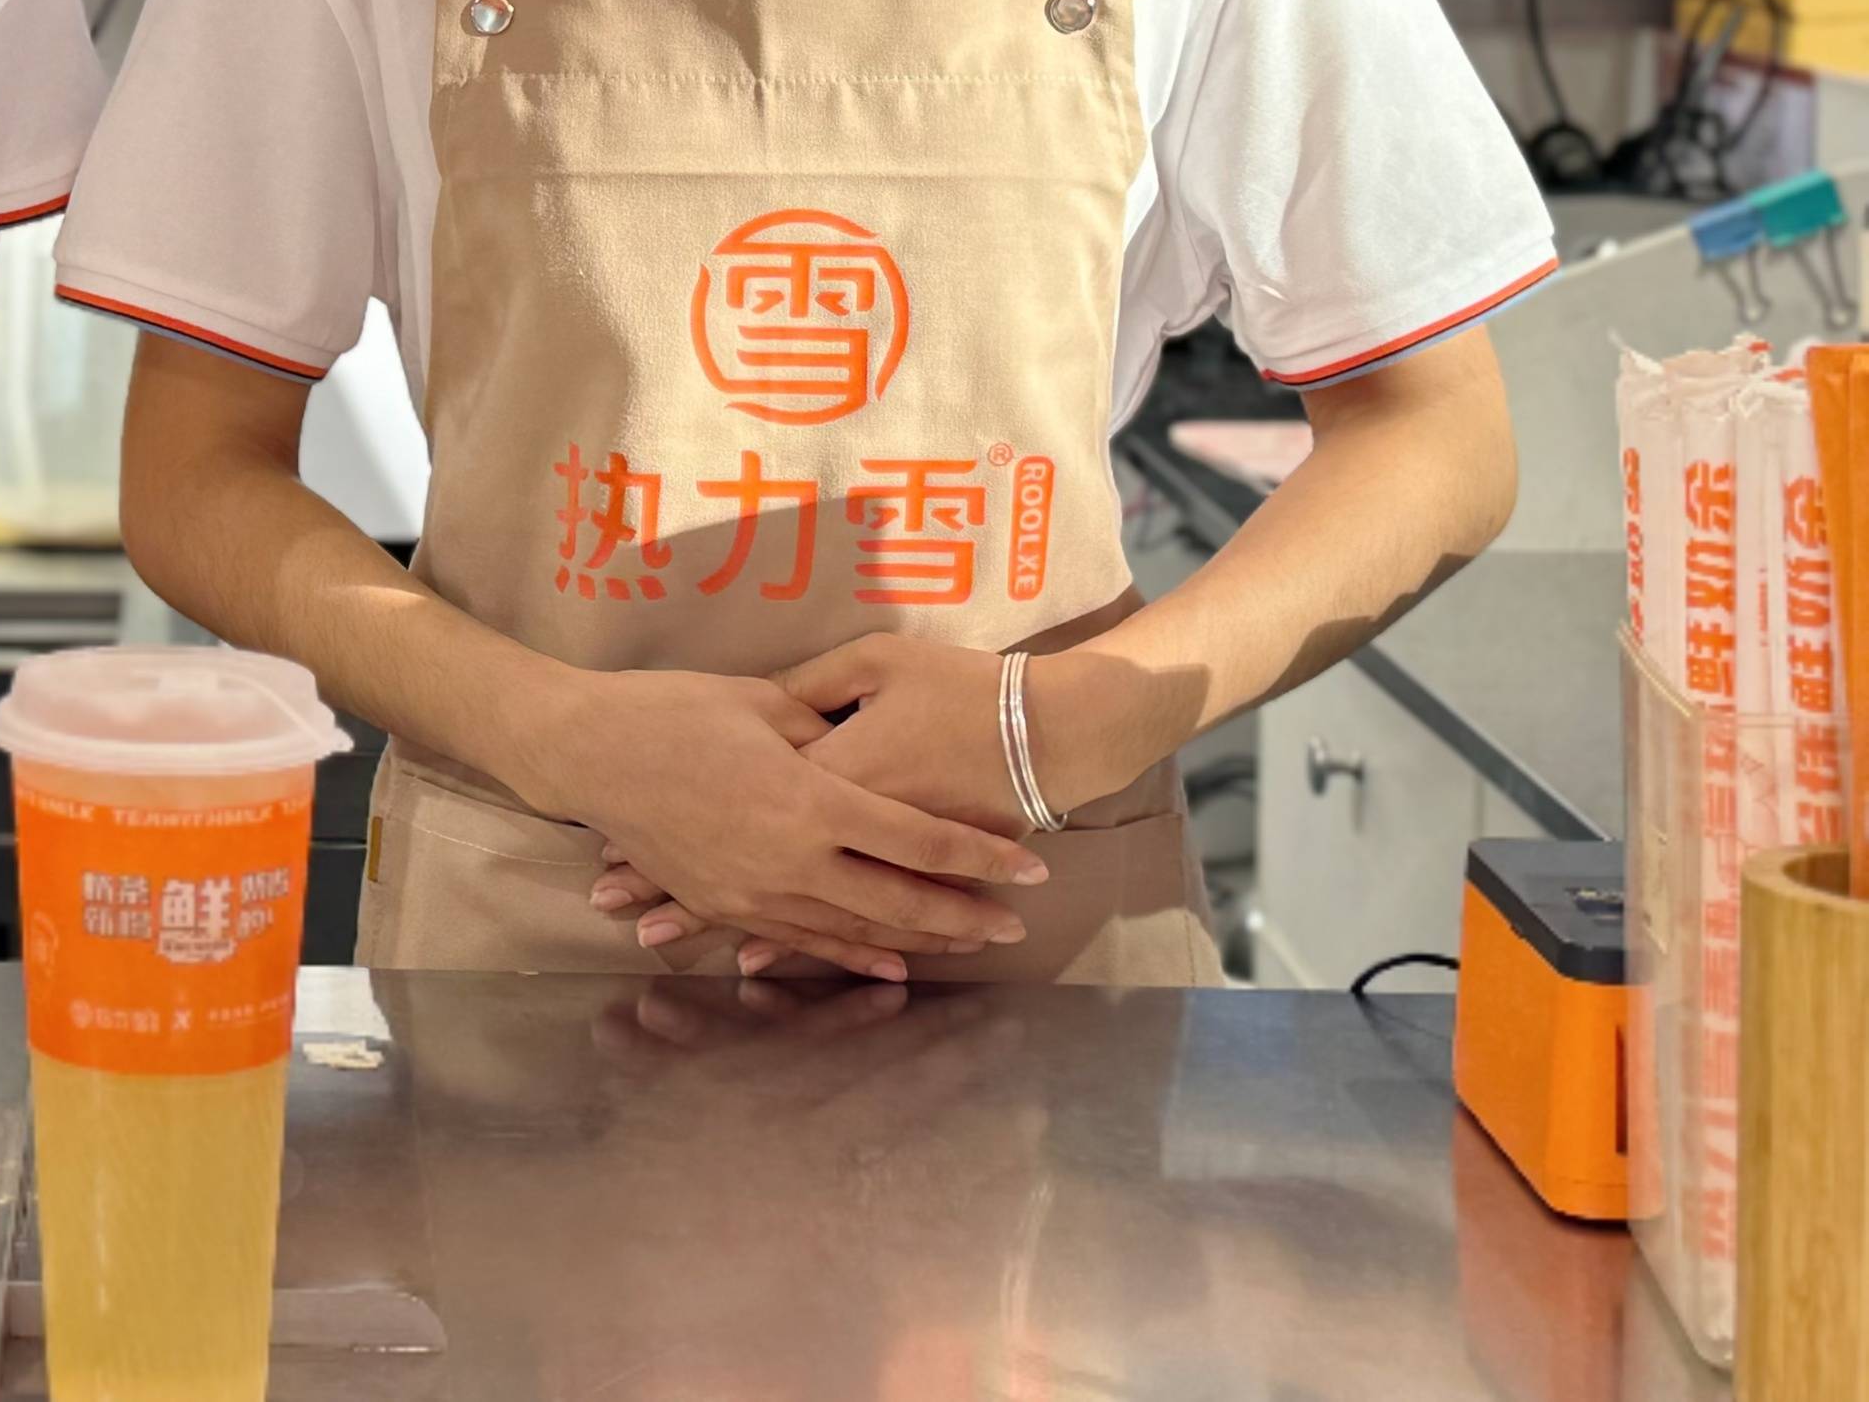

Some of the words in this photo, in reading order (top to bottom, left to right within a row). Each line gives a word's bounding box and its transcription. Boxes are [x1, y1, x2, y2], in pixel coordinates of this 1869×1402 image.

[697, 218, 903, 423] 雪
[554, 441, 985, 605] 热力雪
[1014, 460, 1049, 599] ROOLXE
[161, 877, 233, 940] 鲜
